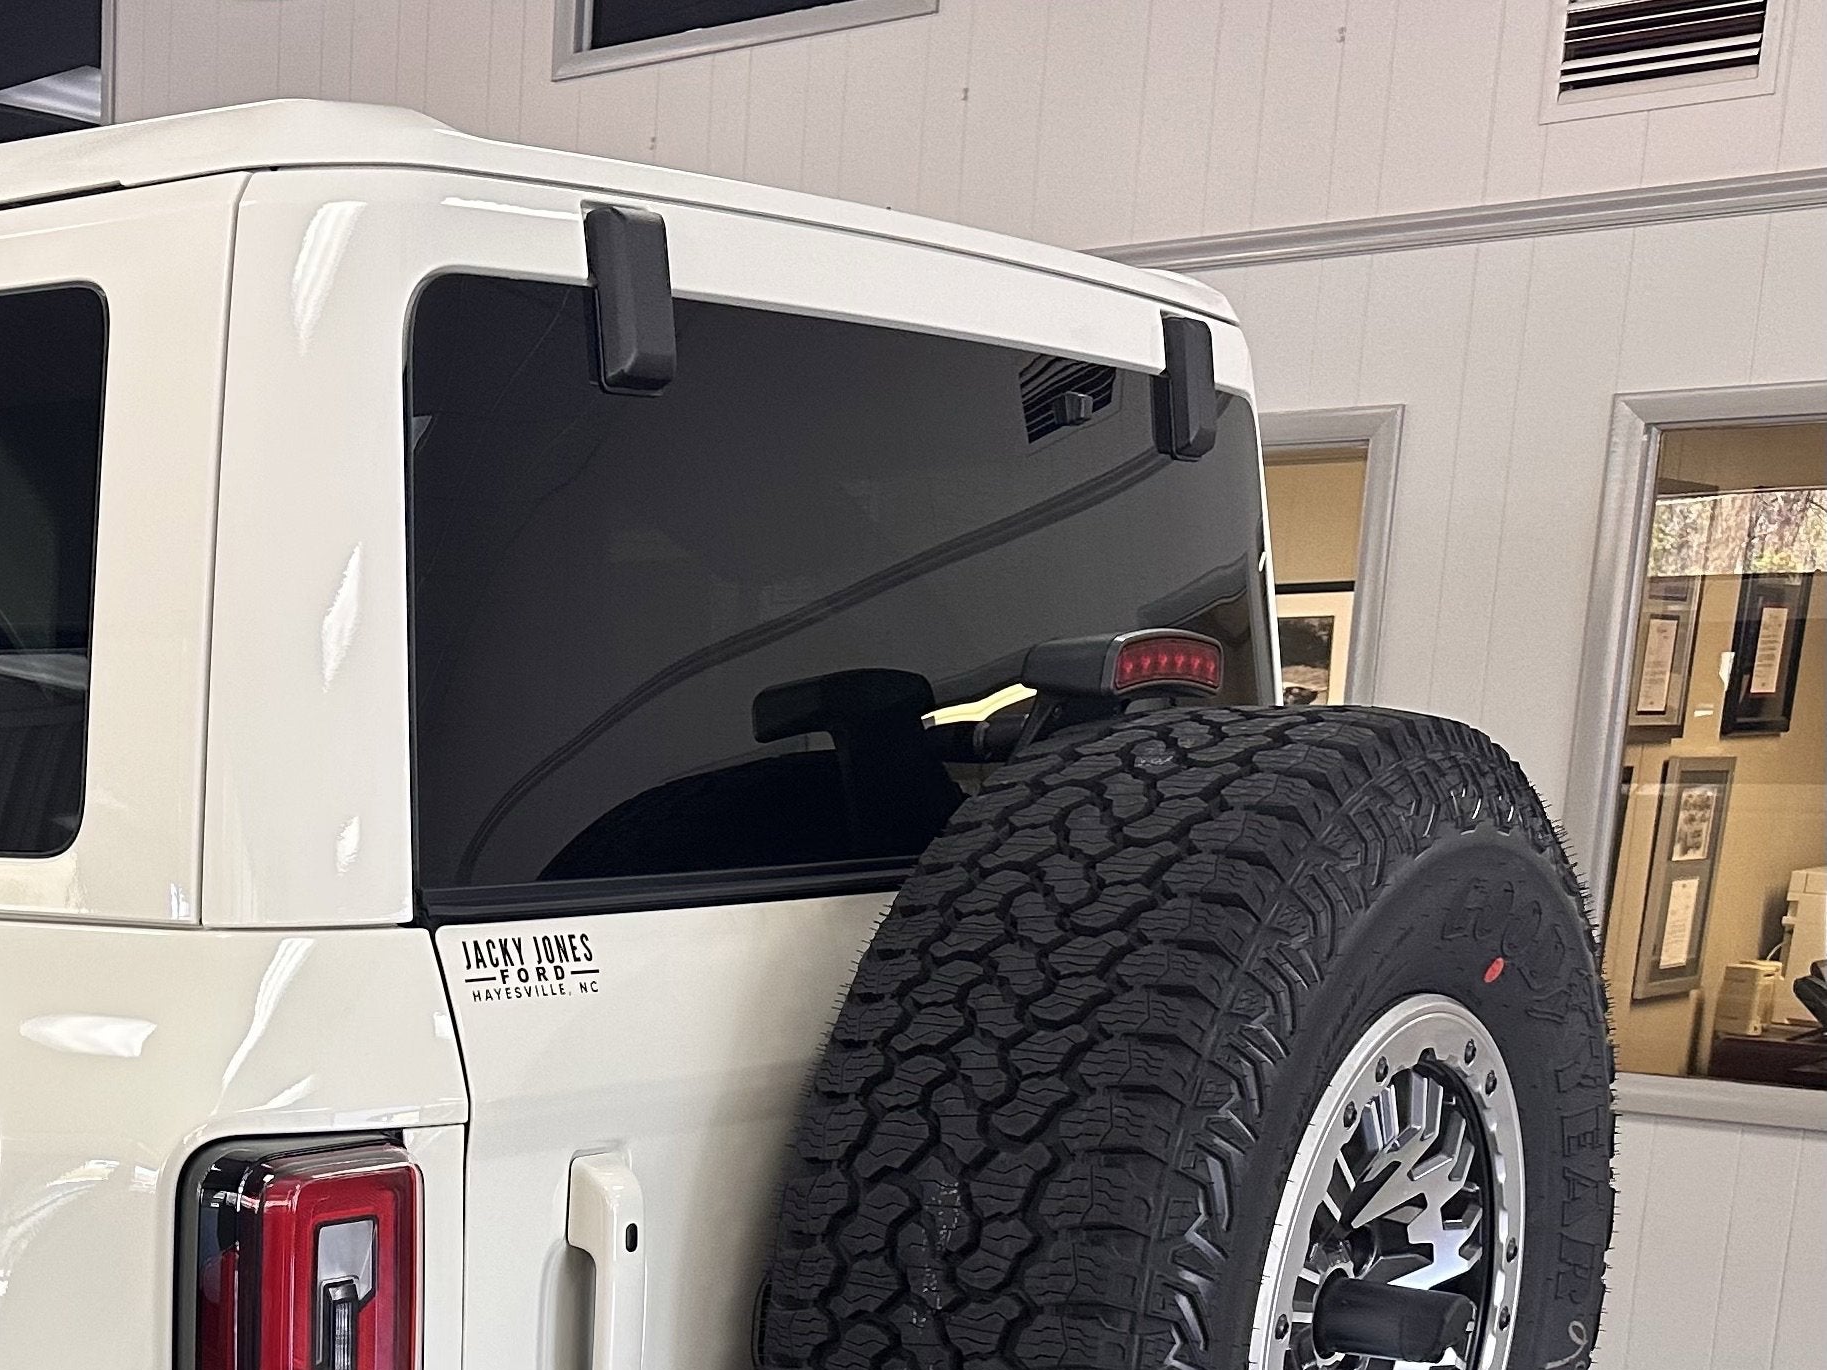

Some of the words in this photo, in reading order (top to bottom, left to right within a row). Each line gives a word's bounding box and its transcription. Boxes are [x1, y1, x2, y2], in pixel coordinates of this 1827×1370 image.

[462, 937, 524, 970] JACKY
[533, 933, 593, 964] JONES
[500, 965, 565, 984] FORD
[472, 983, 571, 1002] HAYESVILLE,
[579, 981, 598, 994] NC
